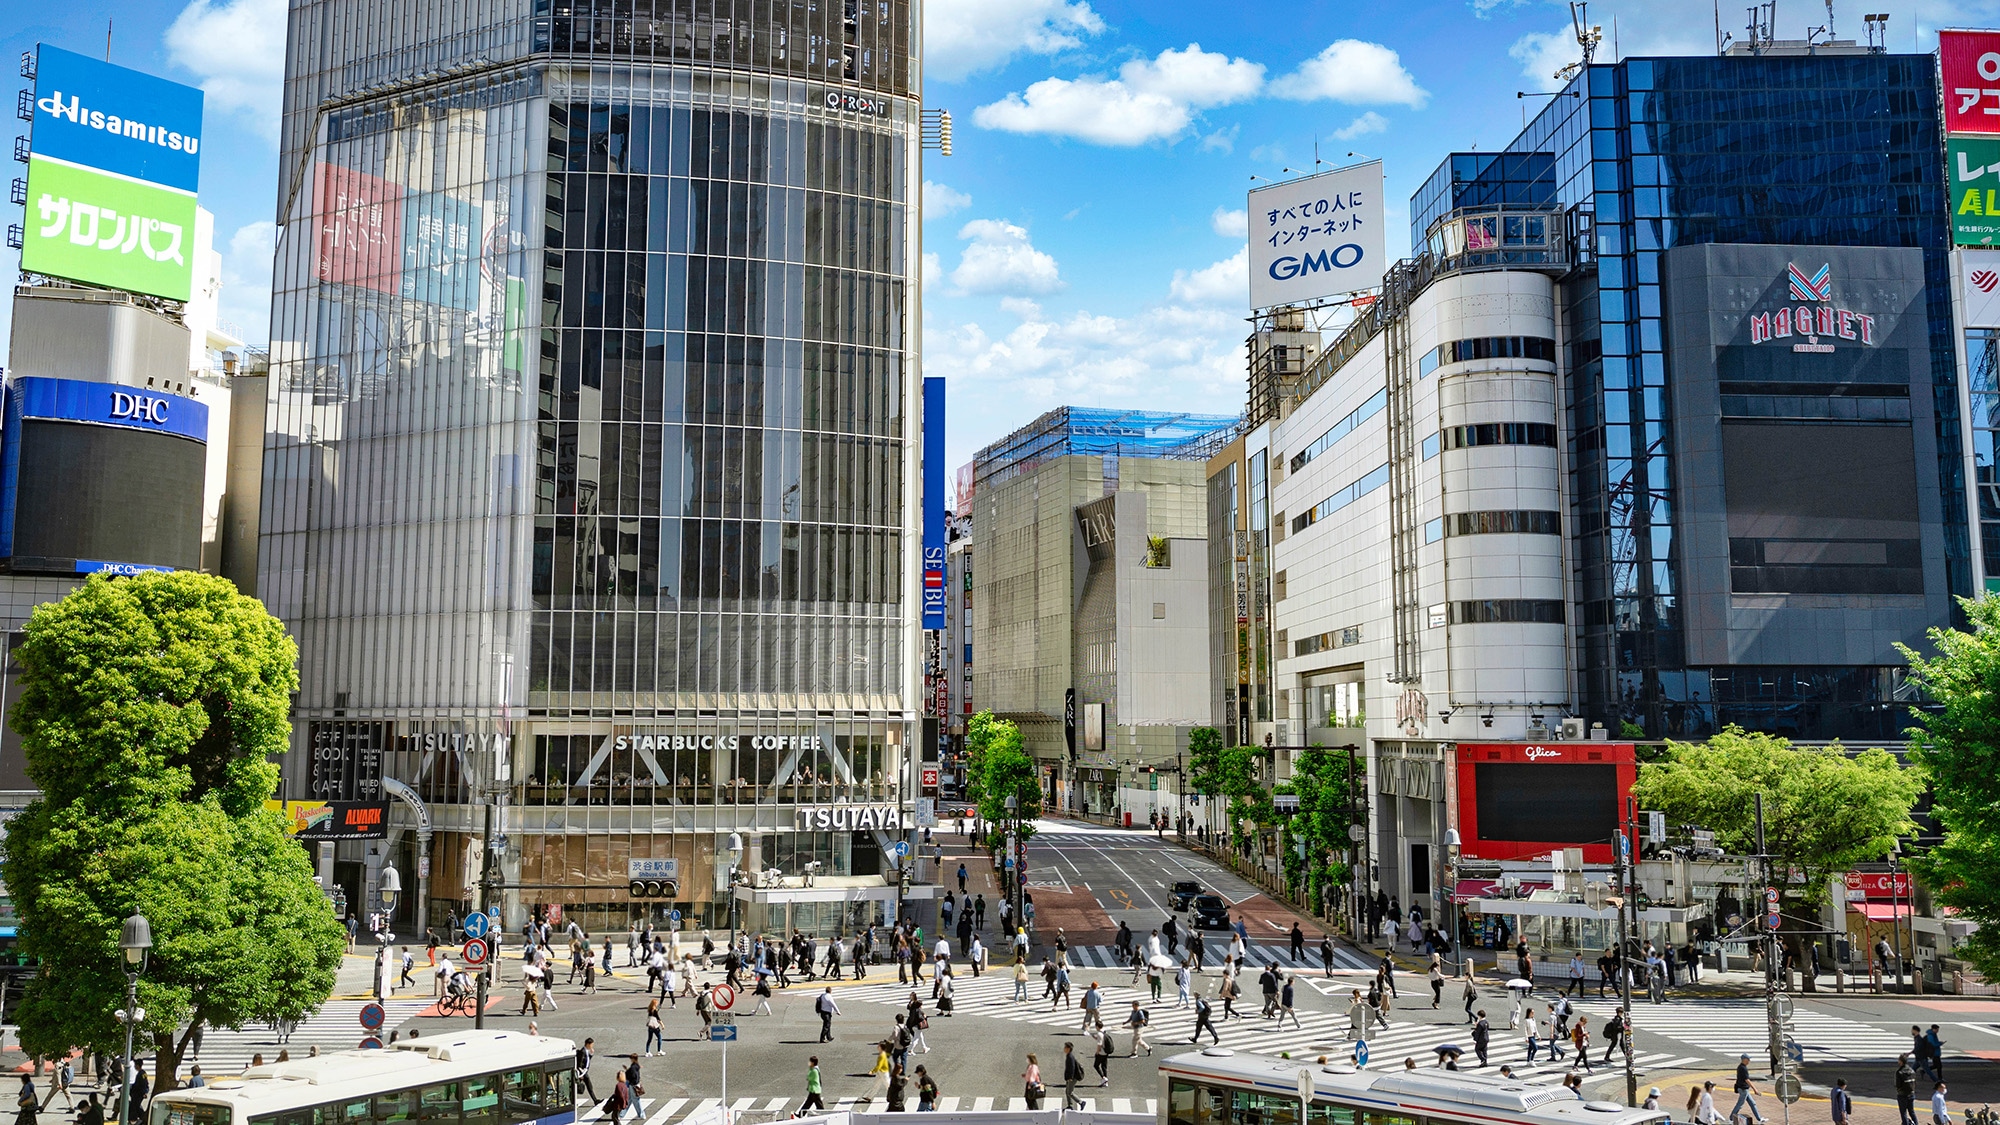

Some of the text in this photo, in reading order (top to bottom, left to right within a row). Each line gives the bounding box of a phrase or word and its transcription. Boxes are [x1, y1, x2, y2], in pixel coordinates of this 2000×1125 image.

[37, 90, 198, 155] Hisamitsu
[1267, 191, 1363, 226] すべての人に
[38, 193, 184, 267] サロンパス
[1268, 213, 1363, 248] インターネット
[1268, 243, 1364, 281] GMO
[1751, 306, 1875, 345] MAGNET
[111, 391, 170, 423] DHC
[924, 546, 943, 616] SEIBU
[1238, 593, 1247, 617] 処方せん
[314, 747, 350, 761] BOOK
[411, 733, 505, 753] TSUTAYA
[615, 735, 821, 751] STARBUCKS COFFEE
[1525, 746, 1562, 761] Glico
[359, 779, 379, 787] WIED
[924, 771, 936, 784] 本
[1088, 769, 1103, 781] ZARA
[345, 808, 382, 825] ALVARK
[801, 806, 901, 829] TSUTAYA
[632, 861, 674, 871] 渋谷駅前
